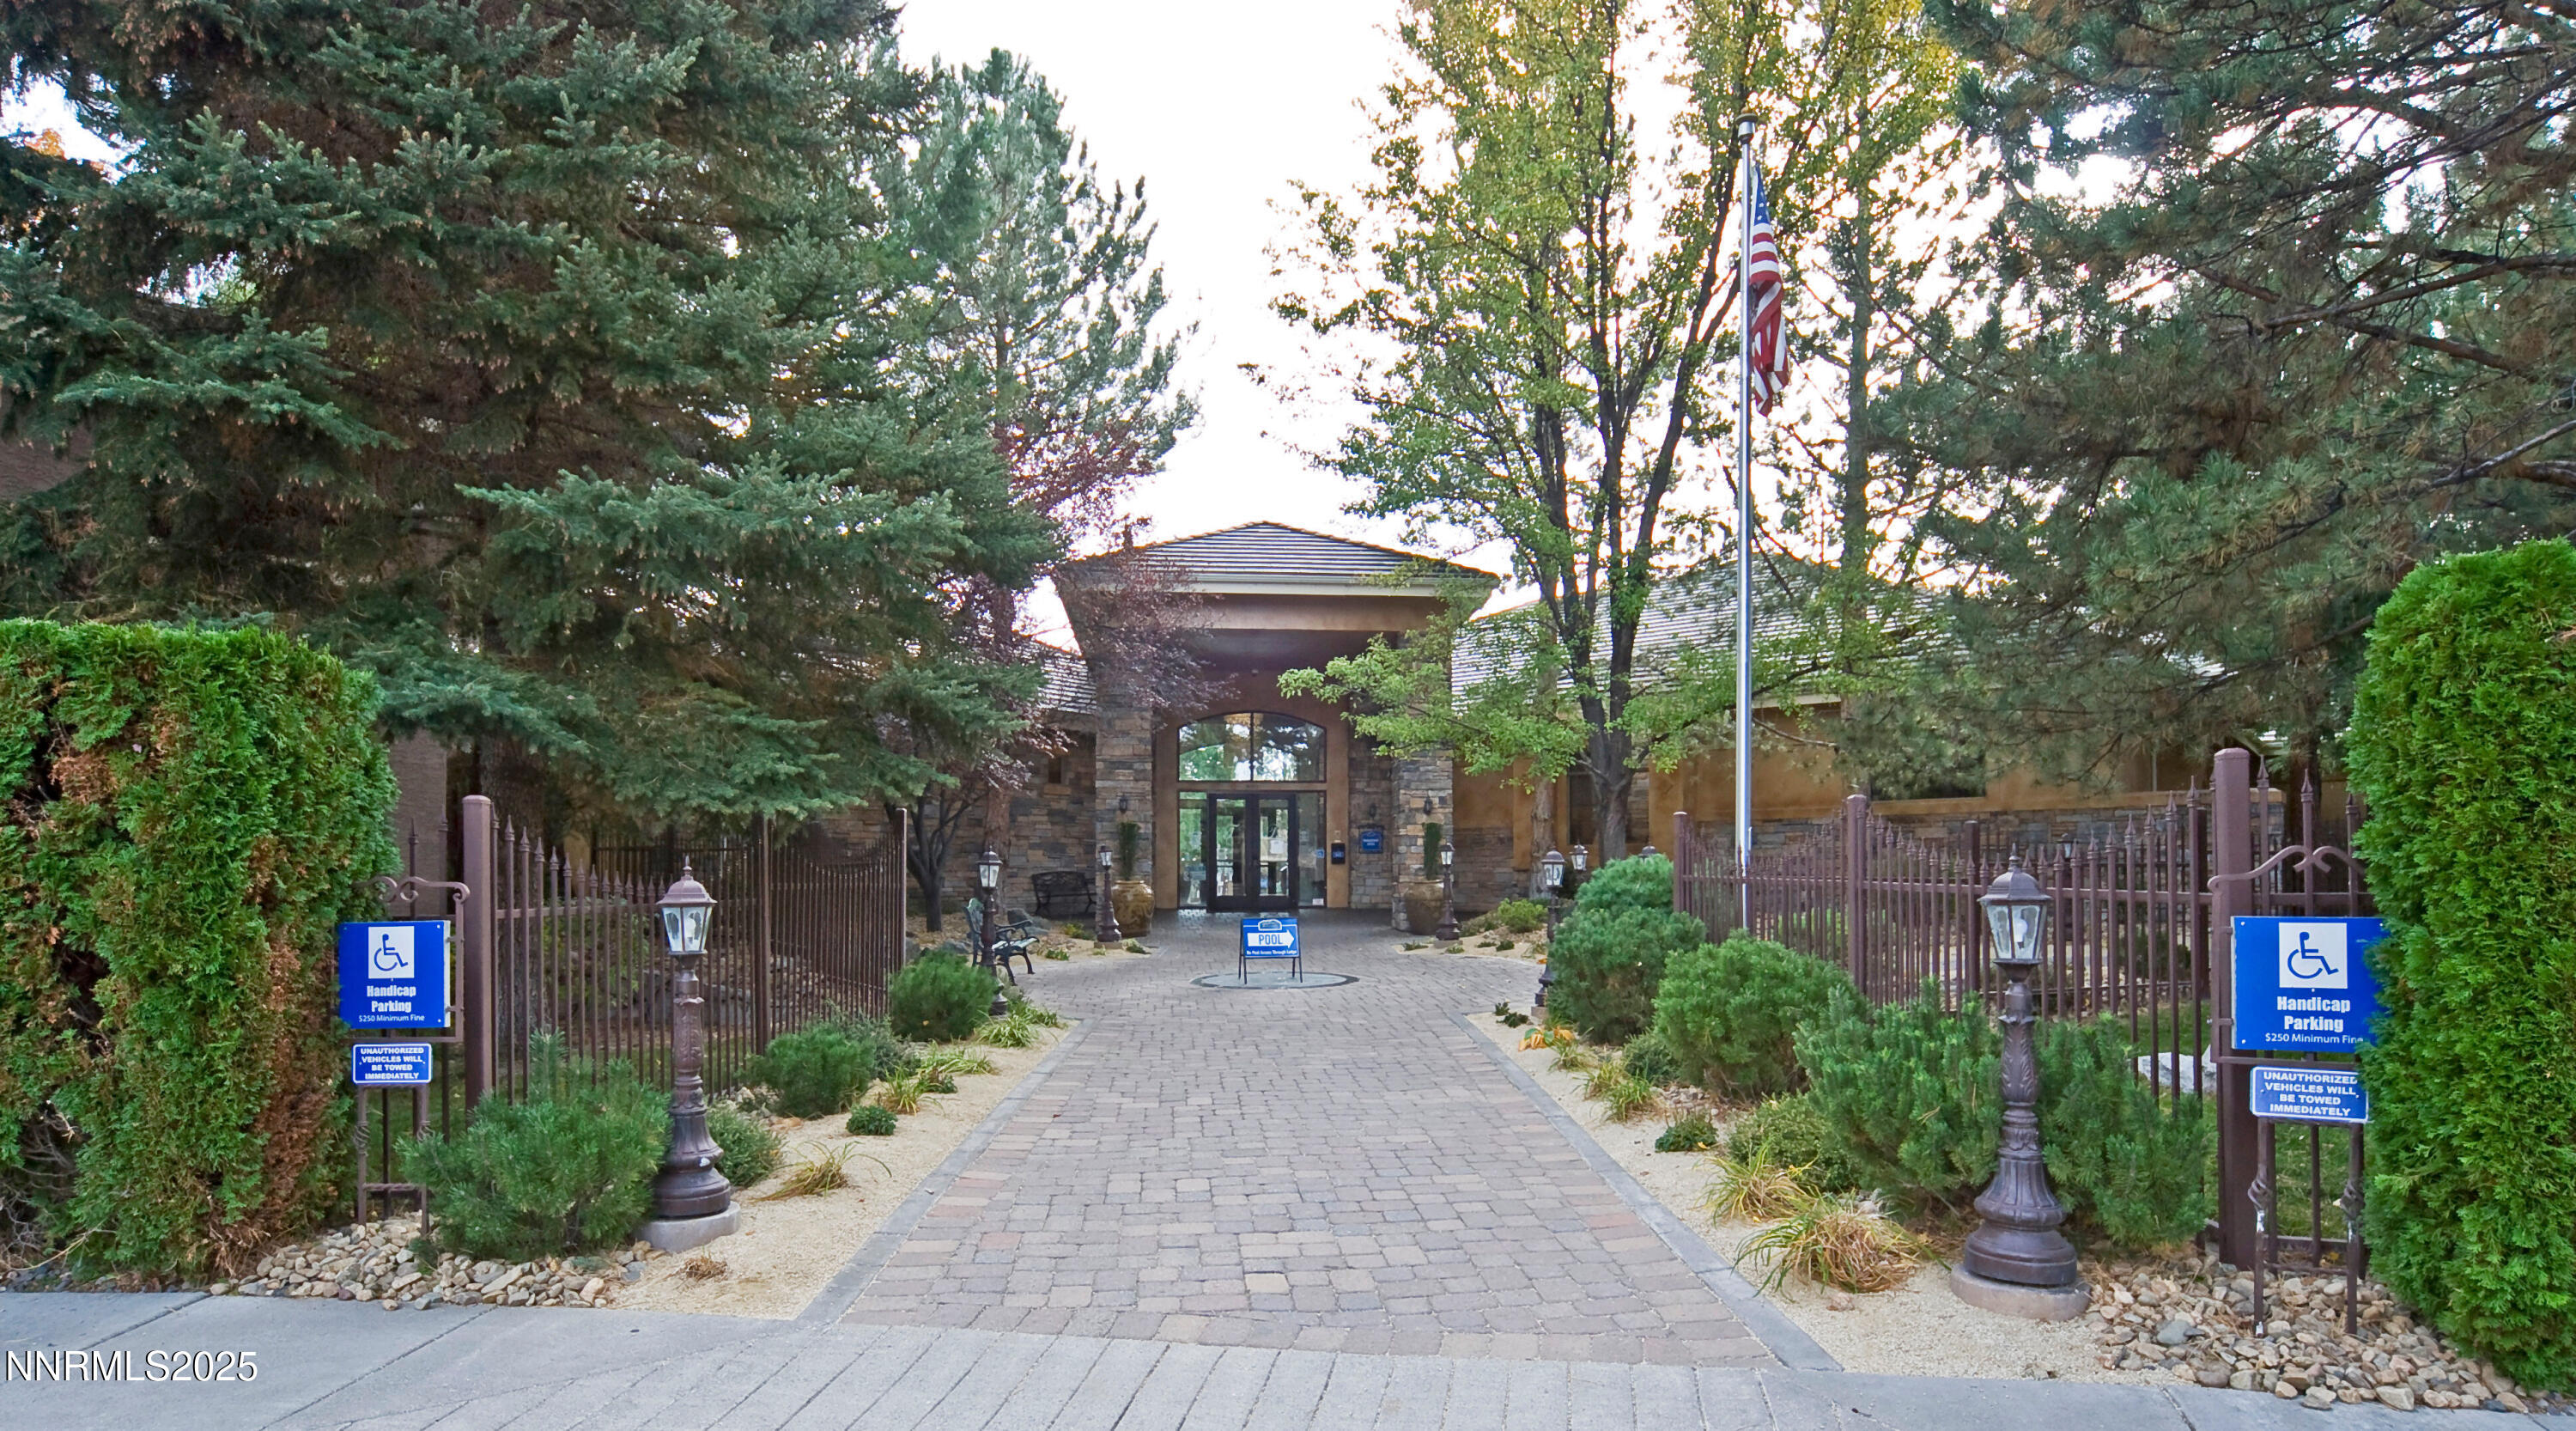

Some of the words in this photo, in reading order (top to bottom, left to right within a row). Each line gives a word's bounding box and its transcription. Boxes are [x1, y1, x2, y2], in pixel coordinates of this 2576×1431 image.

[1259, 934, 1284, 945] POOL
[367, 985, 416, 997] Handicap
[371, 1000, 412, 1014] Parking
[2277, 996, 2351, 1014] Handicap
[2284, 1015, 2344, 1033] Parking
[2265, 1032, 2290, 1043] $250
[2292, 1033, 2340, 1044] Minimum
[2263, 1071, 2358, 1084] UNAUTHORIZED
[2265, 1082, 2324, 1093] VEHICLES
[2327, 1085, 2356, 1095] WILL
[2279, 1093, 2295, 1103] BE
[2298, 1095, 2342, 1105] TOWED
[2269, 1103, 2351, 1117] IMMEDIATELY
